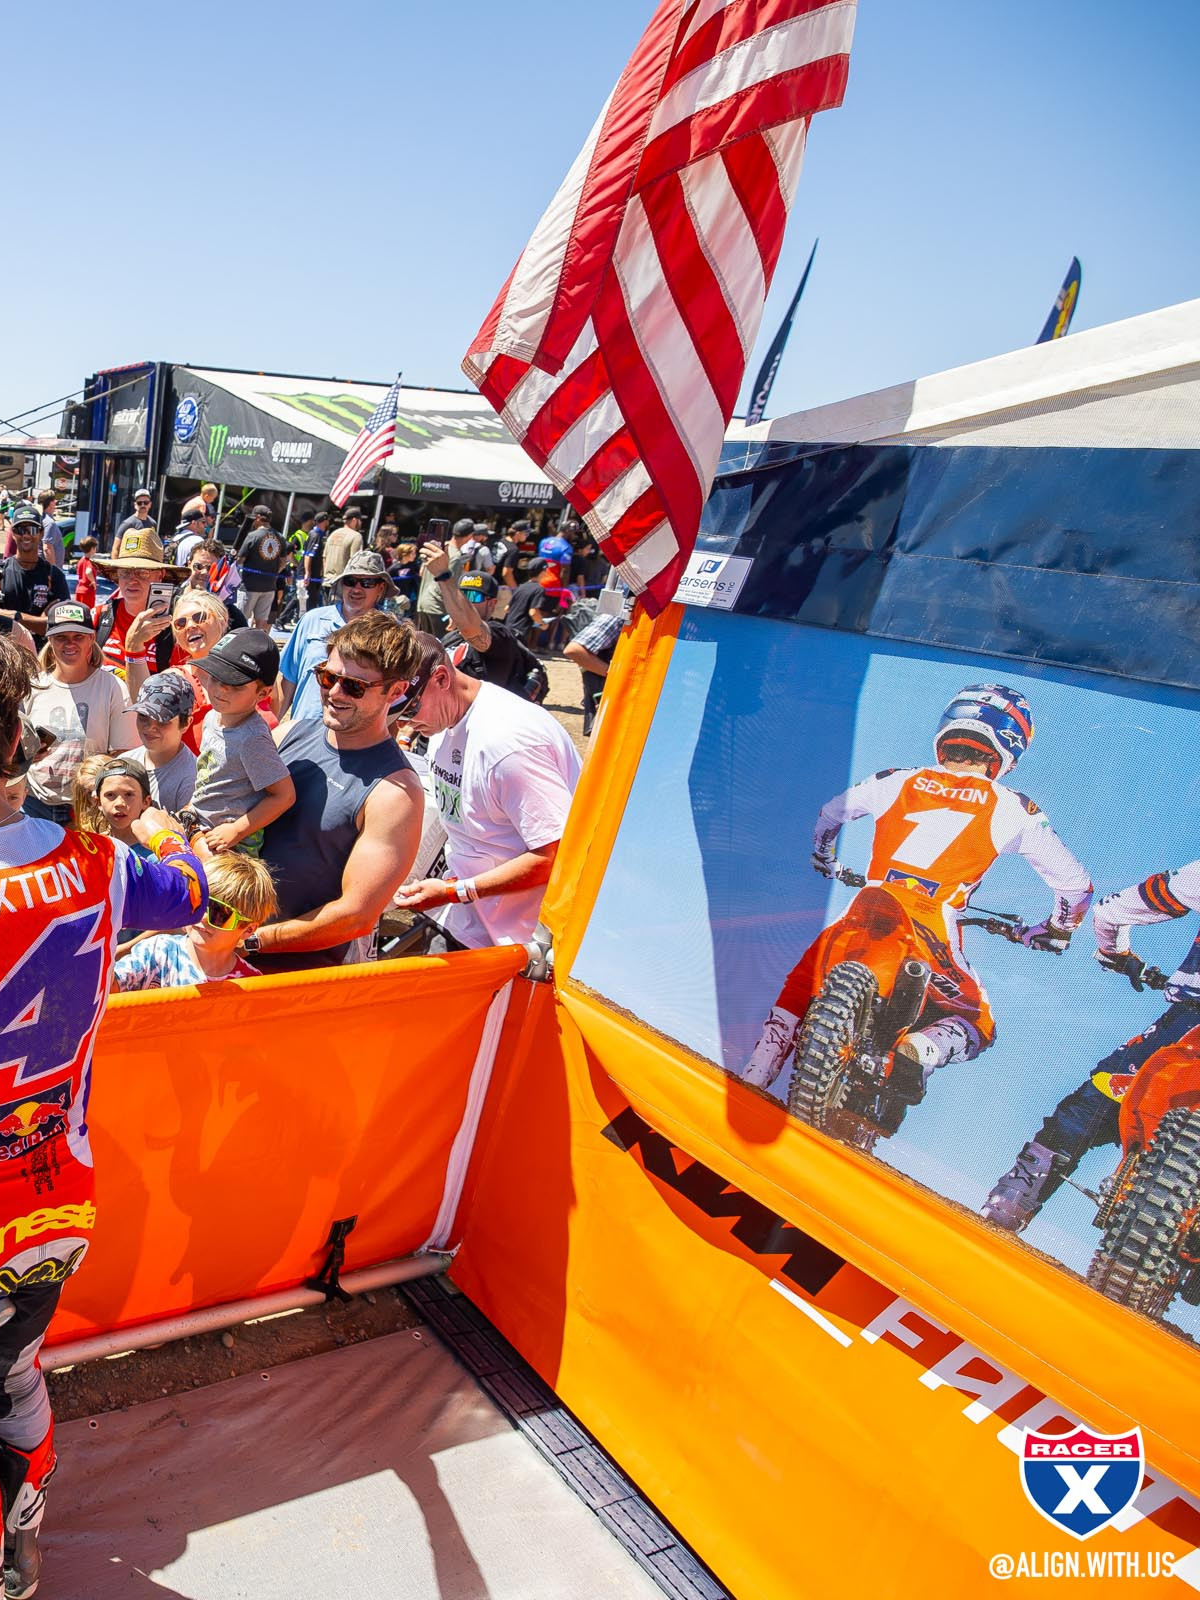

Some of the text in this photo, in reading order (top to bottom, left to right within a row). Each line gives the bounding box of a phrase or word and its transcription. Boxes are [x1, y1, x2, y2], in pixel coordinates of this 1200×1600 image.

[226, 434, 266, 449] MONSTER
[280, 442, 313, 458] YAMAHA
[511, 484, 554, 499] YAMAHA
[913, 777, 989, 805] SEXTON
[890, 807, 977, 870] 1
